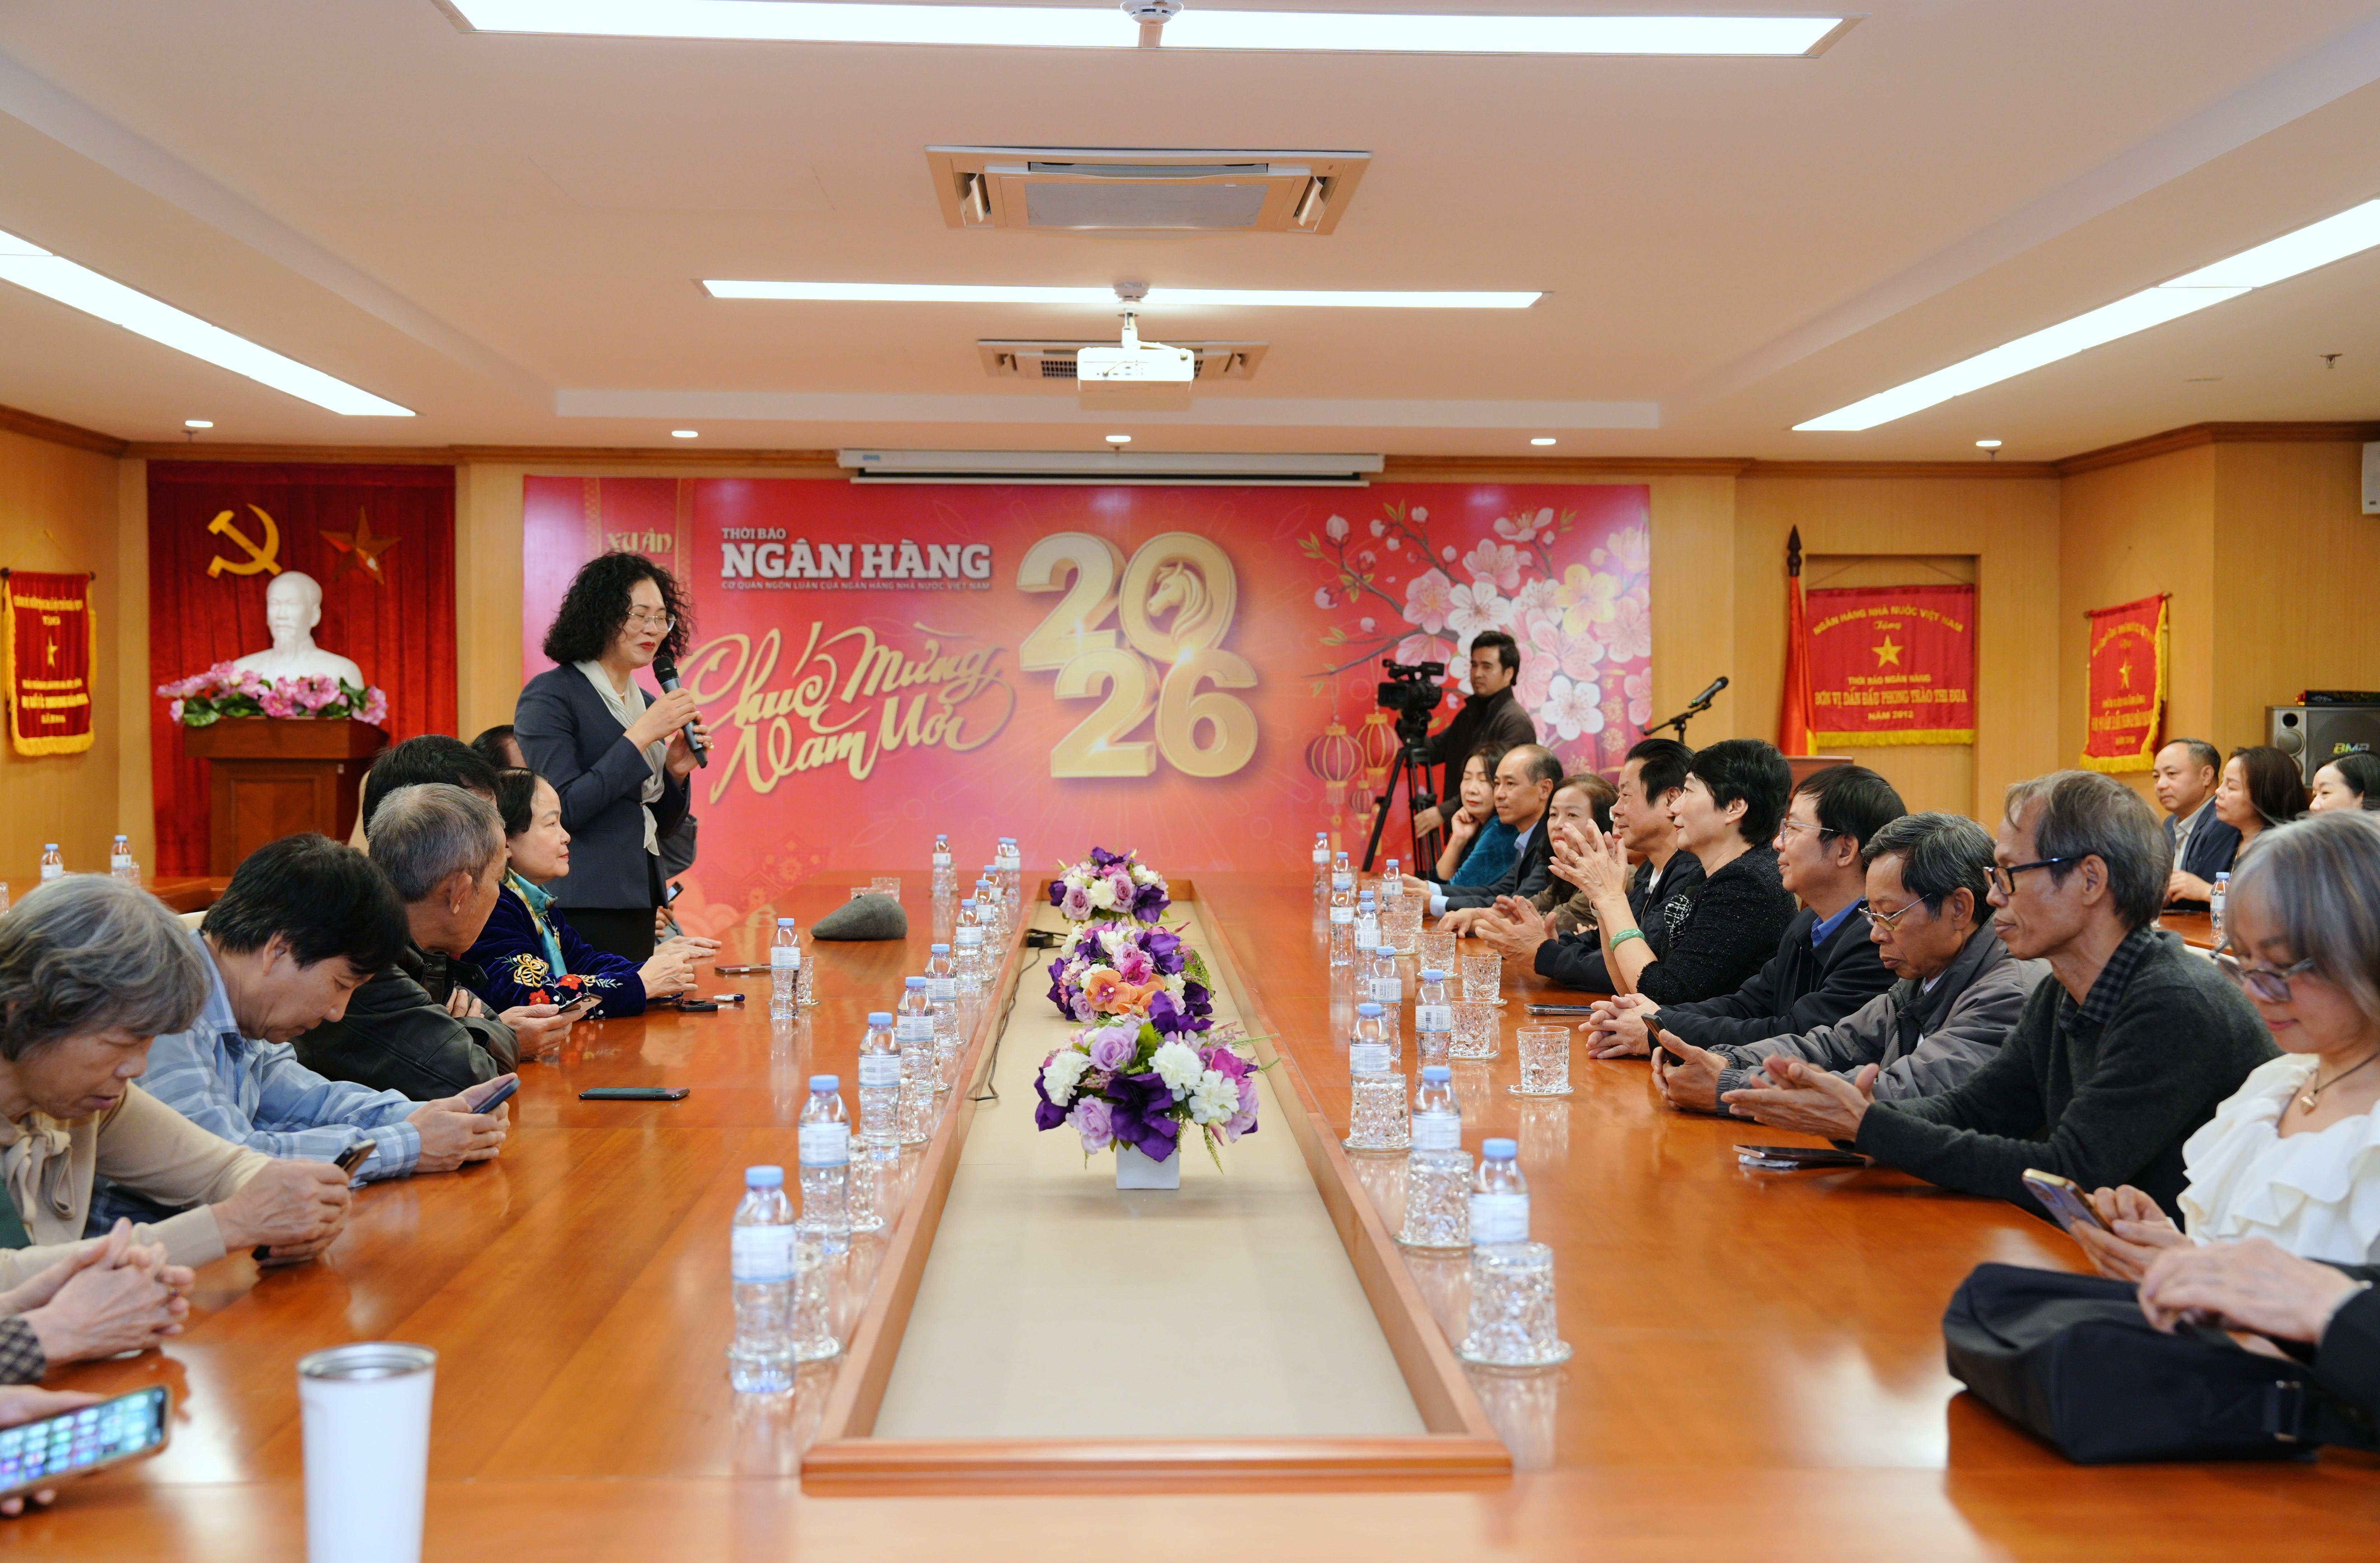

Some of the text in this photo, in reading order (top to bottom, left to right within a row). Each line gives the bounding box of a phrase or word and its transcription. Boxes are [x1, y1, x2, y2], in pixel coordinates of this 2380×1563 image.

[721, 527, 786, 539] THỜI BÁO
[721, 538, 991, 579] NGÂN HÀNG
[969, 580, 991, 590] NAM
